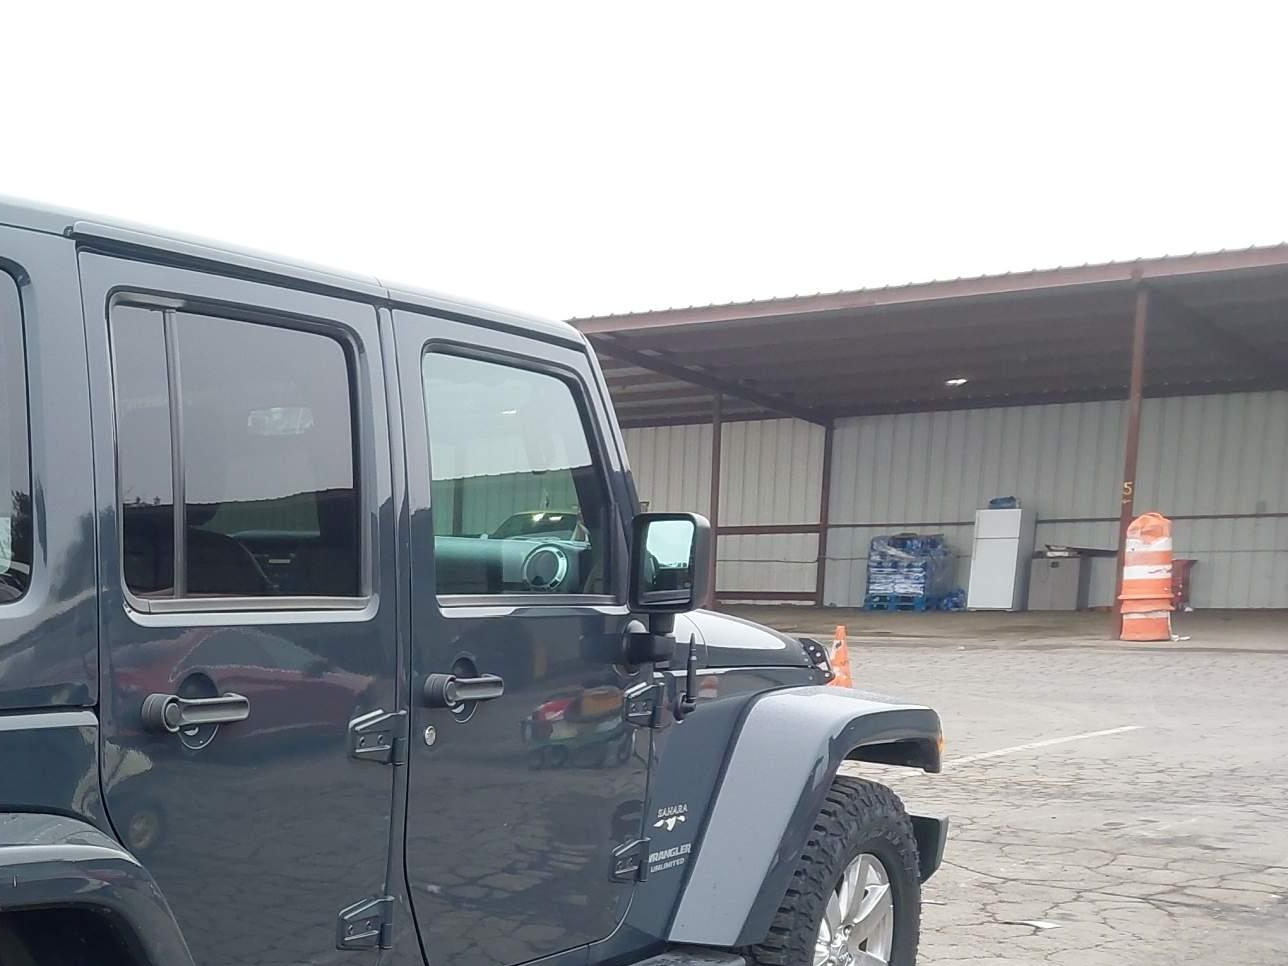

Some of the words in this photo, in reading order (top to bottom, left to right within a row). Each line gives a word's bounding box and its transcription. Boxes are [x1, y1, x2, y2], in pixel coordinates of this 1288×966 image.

[1122, 481, 1133, 496] 5
[657, 804, 689, 818] SAHARA
[650, 857, 685, 873] UNLIMITED
